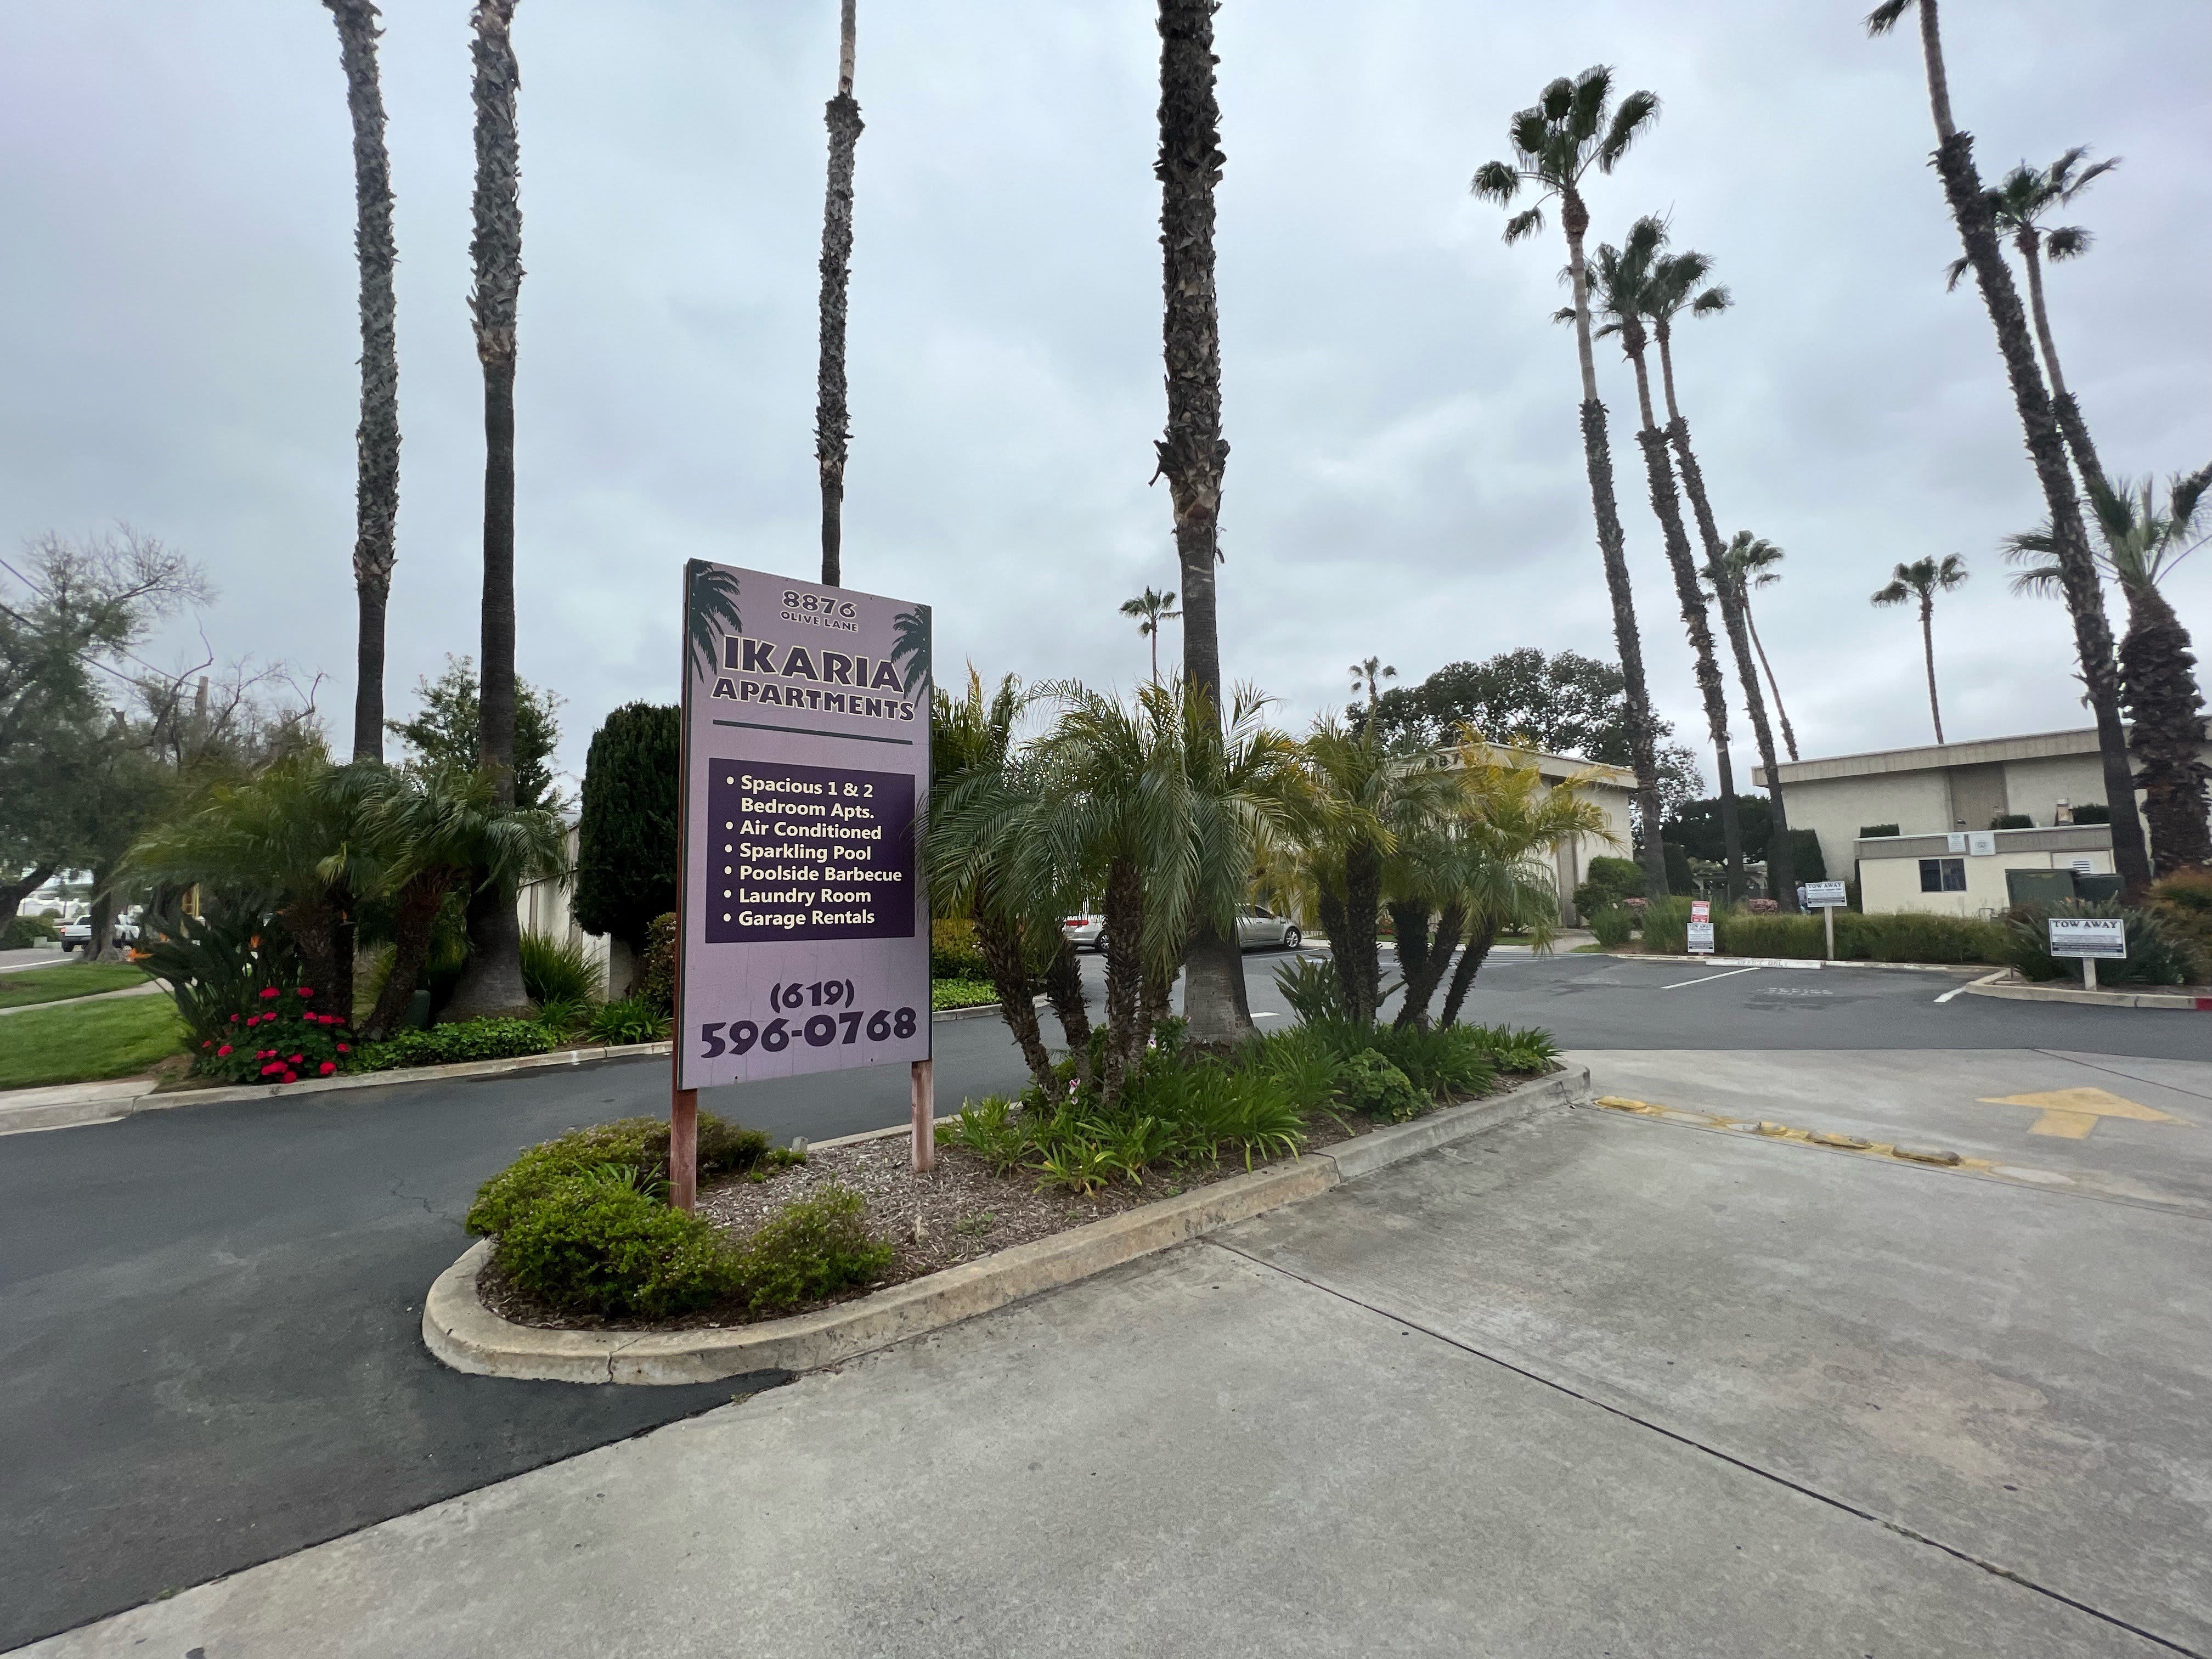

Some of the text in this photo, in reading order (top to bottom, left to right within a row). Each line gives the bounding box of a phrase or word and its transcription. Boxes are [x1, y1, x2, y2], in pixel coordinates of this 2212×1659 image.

[782, 590, 857, 619] 8876
[780, 611, 858, 633] OLIVE LANE
[724, 634, 904, 693] IKARIA
[711, 678, 916, 721] APARTMENTS
[741, 775, 873, 798] Spacious 1 & 2
[742, 798, 874, 821] Bedroom Apts.
[740, 820, 882, 840] Air Conditioned
[740, 843, 871, 863] Sparkling Pool
[740, 865, 902, 882] Poolside Barbecue
[739, 888, 871, 906] Laundry Room
[738, 909, 875, 929] Garage Rentals
[770, 979, 855, 1013] (619)
[701, 1007, 917, 1058] 596-0768
